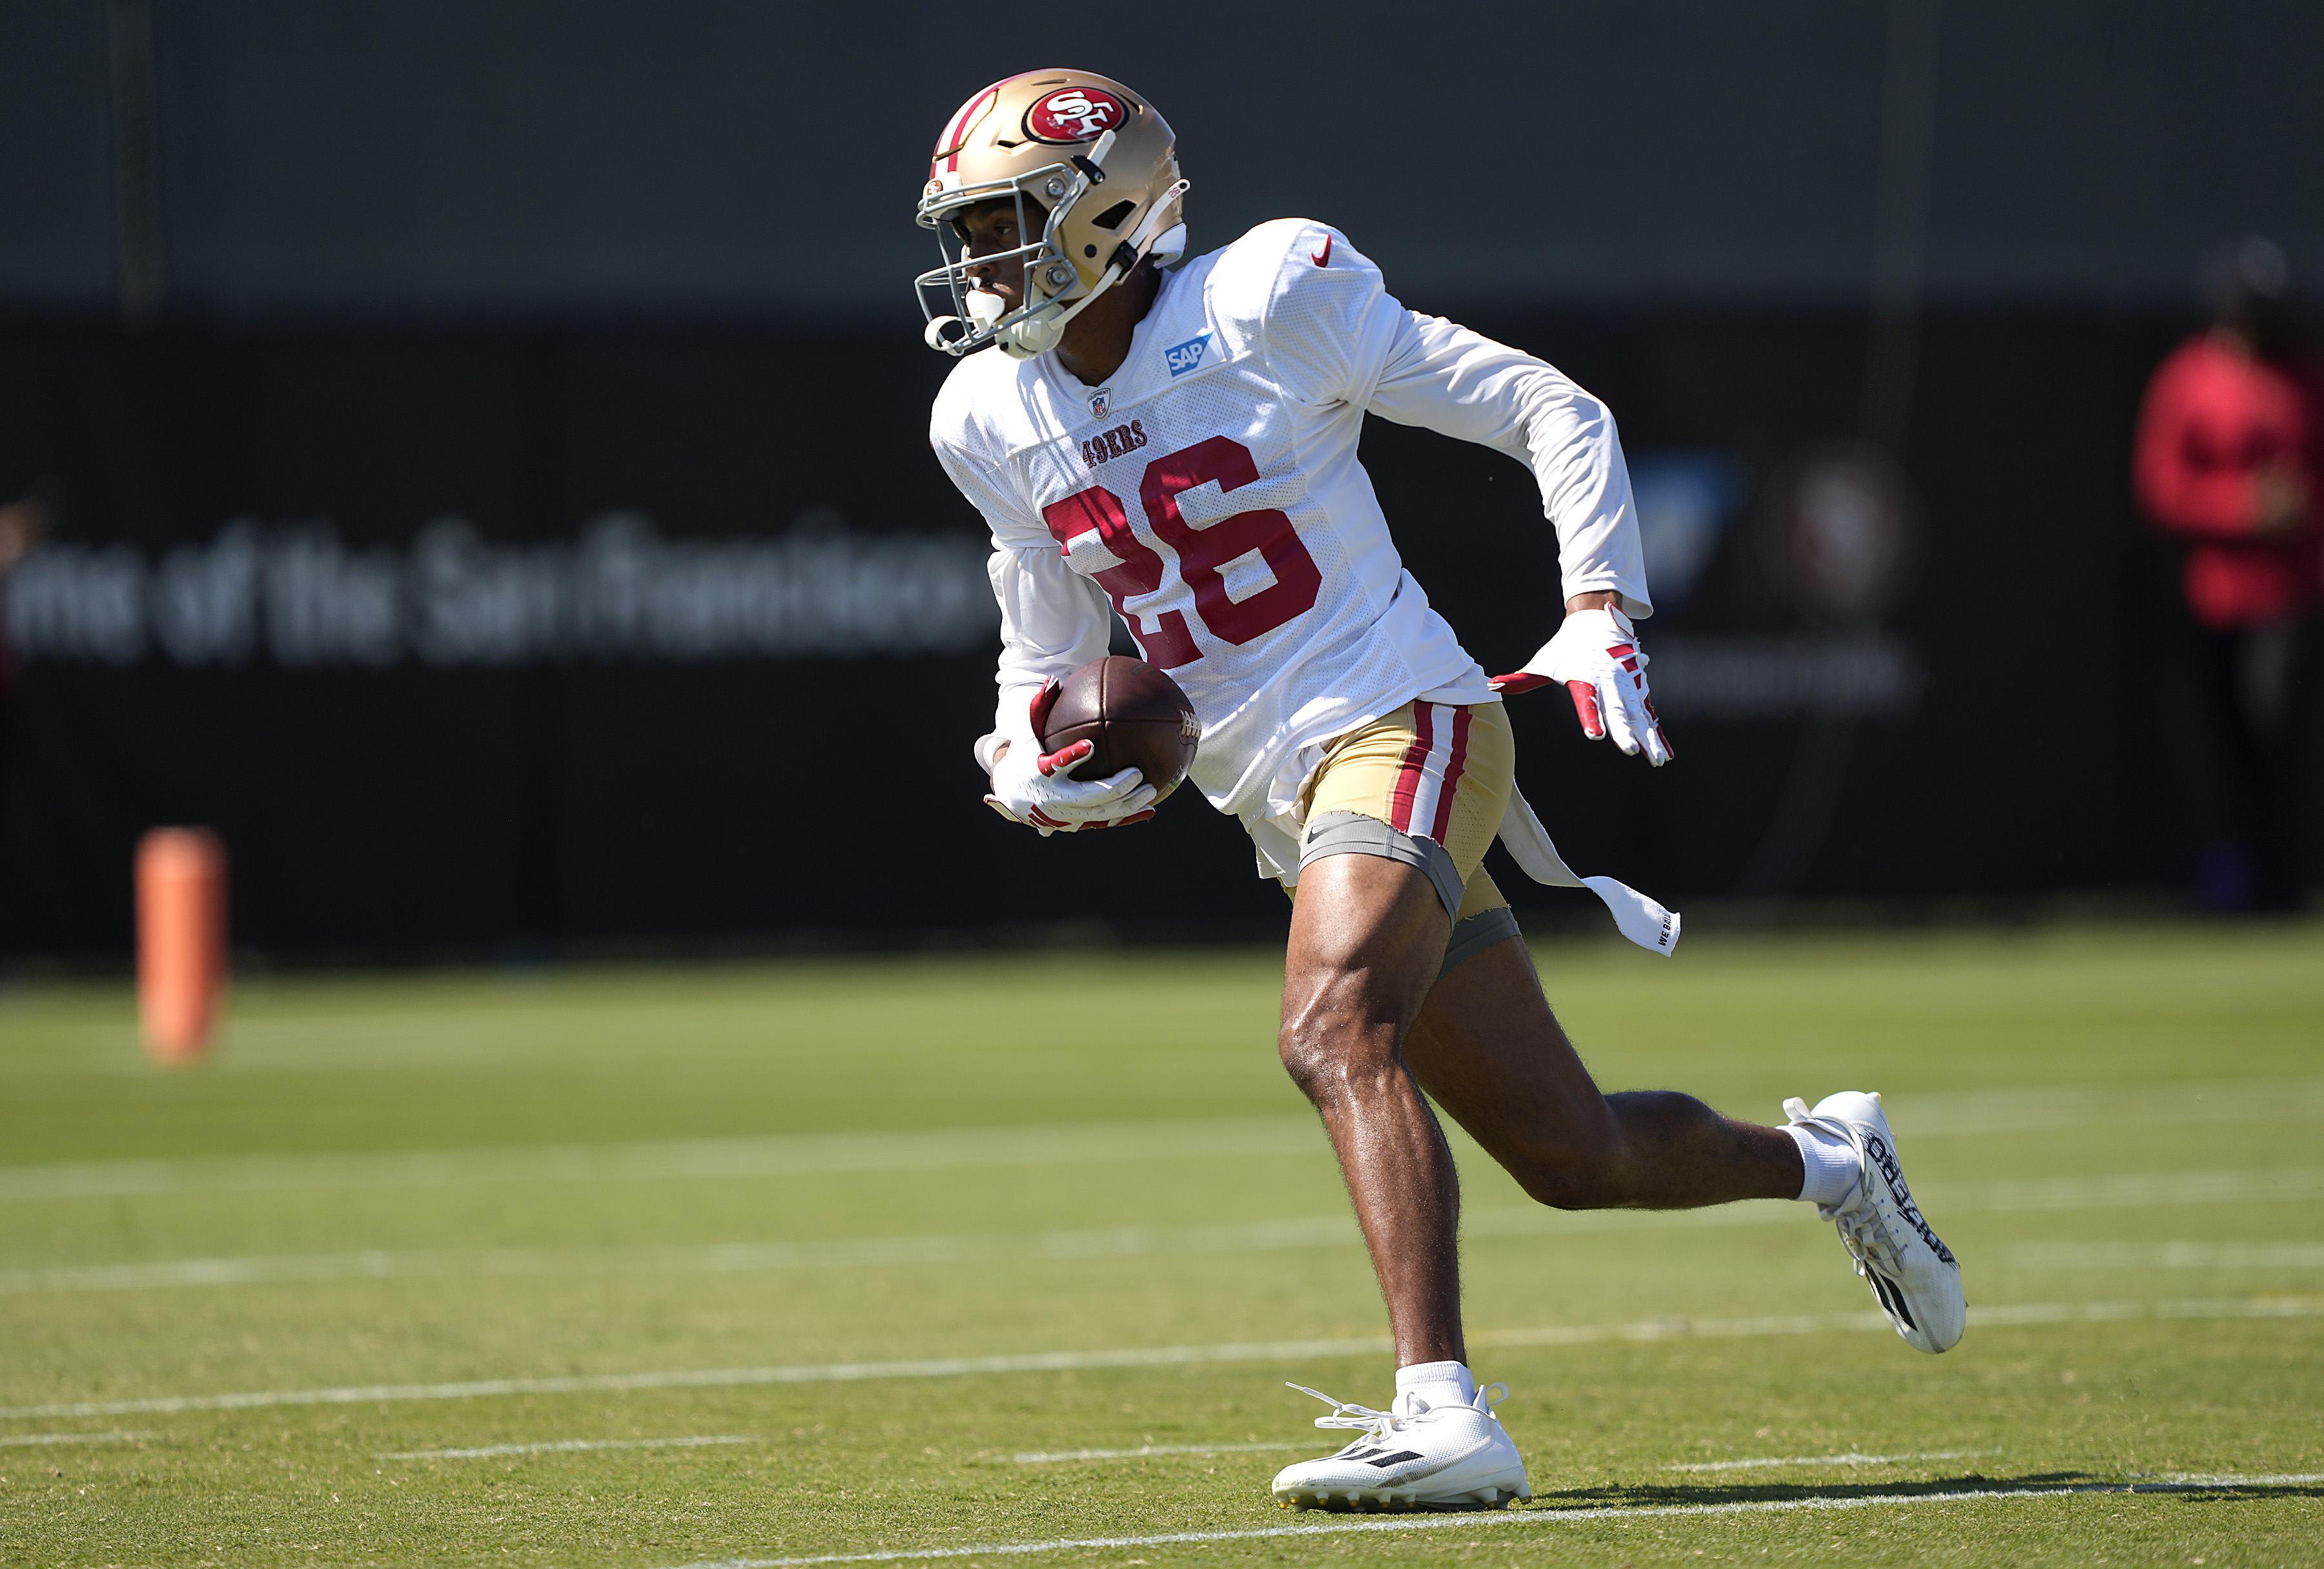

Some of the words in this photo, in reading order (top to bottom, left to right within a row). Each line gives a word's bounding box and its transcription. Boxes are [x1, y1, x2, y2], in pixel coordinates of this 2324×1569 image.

[1046, 90, 1114, 136] SF
[1168, 187, 1181, 198] 26
[1168, 343, 1203, 371] SAP
[1094, 404, 1106, 414] NFL
[1082, 419, 1148, 469] 49ERS
[1042, 435, 1322, 670] 26
[1658, 930, 1669, 947] WE
